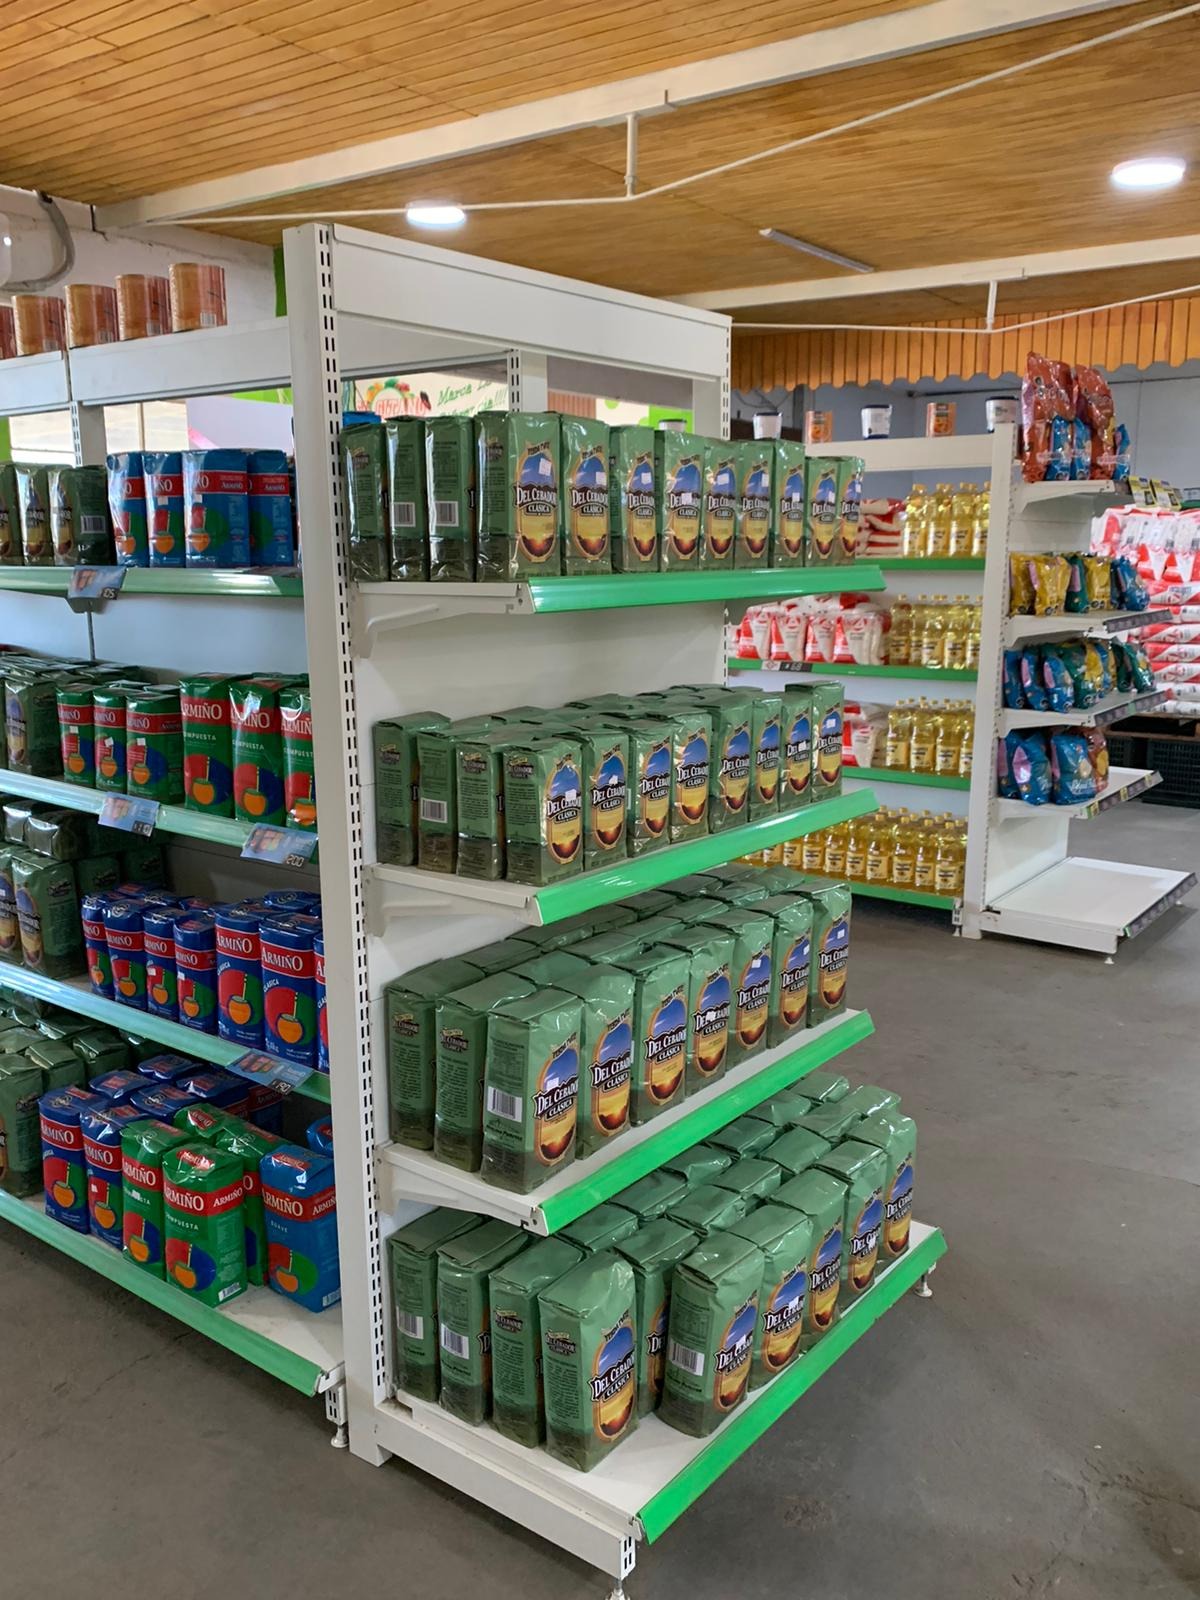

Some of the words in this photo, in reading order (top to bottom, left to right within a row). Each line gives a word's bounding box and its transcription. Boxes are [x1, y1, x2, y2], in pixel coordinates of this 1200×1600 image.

[516, 487, 531, 504] DEL
[572, 489, 586, 506] DEL
[628, 493, 641, 507] DEL
[528, 504, 550, 514] CLASICA
[583, 505, 603, 514] CLASICA
[281, 717, 312, 735] ARMIÑ
[284, 747, 313, 758] COMPUEST
[723, 759, 735, 772] DEL
[678, 767, 691, 782] DEL
[642, 778, 655, 793] DEL
[593, 789, 605, 804] DEL
[547, 800, 560, 816] DEL
[557, 810, 577, 821] CLASICA
[216, 931, 252, 953] ARMIÑO
[261, 947, 303, 971] ARMIÑO
[820, 954, 833, 968] DEL
[782, 973, 795, 988] DEL
[738, 991, 752, 1007] DEL
[705, 1019, 726, 1035] CLASICA
[648, 1041, 664, 1057] DEL
[658, 1045, 681, 1060] CLASICA
[594, 1067, 611, 1084] DEL
[606, 1073, 628, 1088] CLASICA
[538, 1093, 554, 1115] DEL
[548, 1098, 573, 1116] CLASICA
[213, 1187, 242, 1208] ARMIÑO
[313, 1195, 336, 1216] ARMIÑ
[887, 1202, 898, 1218] DEL
[853, 1238, 866, 1255] DEL
[812, 1272, 825, 1289] DEL
[766, 1312, 782, 1330] DEL
[777, 1313, 801, 1333] CLASICA
[719, 1349, 734, 1370] DEL
[594, 1375, 610, 1397] DEL
[606, 1373, 630, 1397] CLASICA
